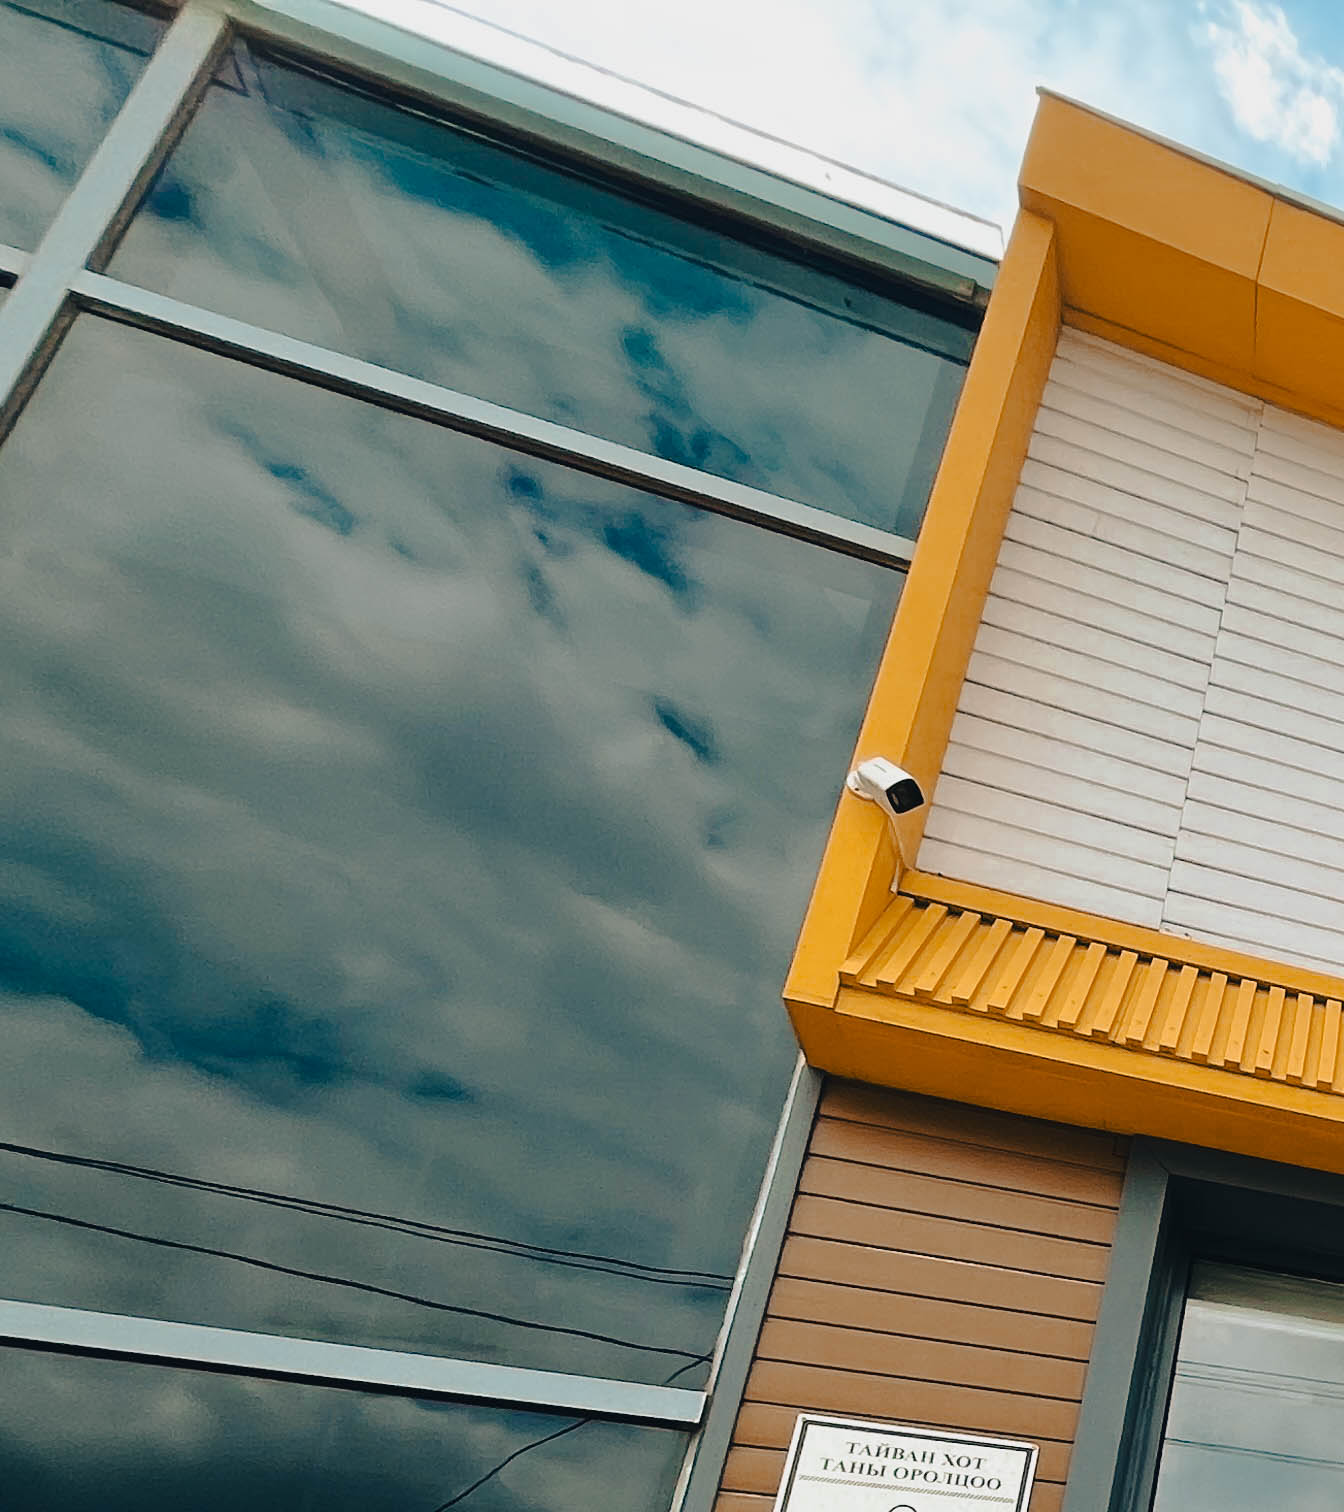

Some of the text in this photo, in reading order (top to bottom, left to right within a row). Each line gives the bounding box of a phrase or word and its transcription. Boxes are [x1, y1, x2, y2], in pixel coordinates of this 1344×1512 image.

[846, 1441, 988, 1471] ТАЙВАН ХОТ
[819, 1457, 1002, 1491] ТАНЫ ОРОЛЦОО
